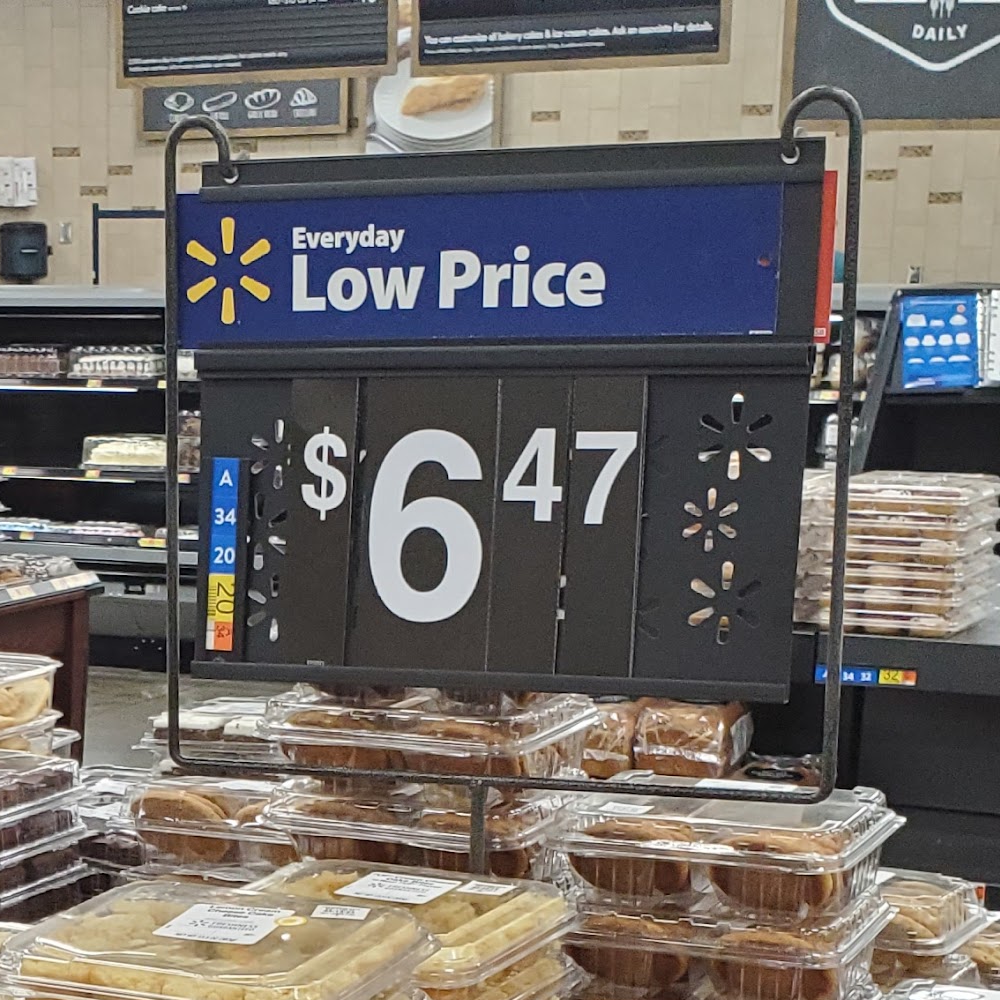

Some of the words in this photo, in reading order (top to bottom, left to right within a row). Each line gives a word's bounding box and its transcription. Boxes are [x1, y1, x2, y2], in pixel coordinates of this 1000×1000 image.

[912, 24, 968, 41] DAILY
[292, 224, 405, 253] Everyday
[292, 254, 425, 312] Low
[439, 245, 606, 309] Price
[219, 469, 233, 487] A
[214, 508, 237, 526] 34
[213, 546, 236, 565] 20
[216, 582, 235, 614] 20
[842, 671, 854, 681] 34
[883, 669, 899, 682] 32
